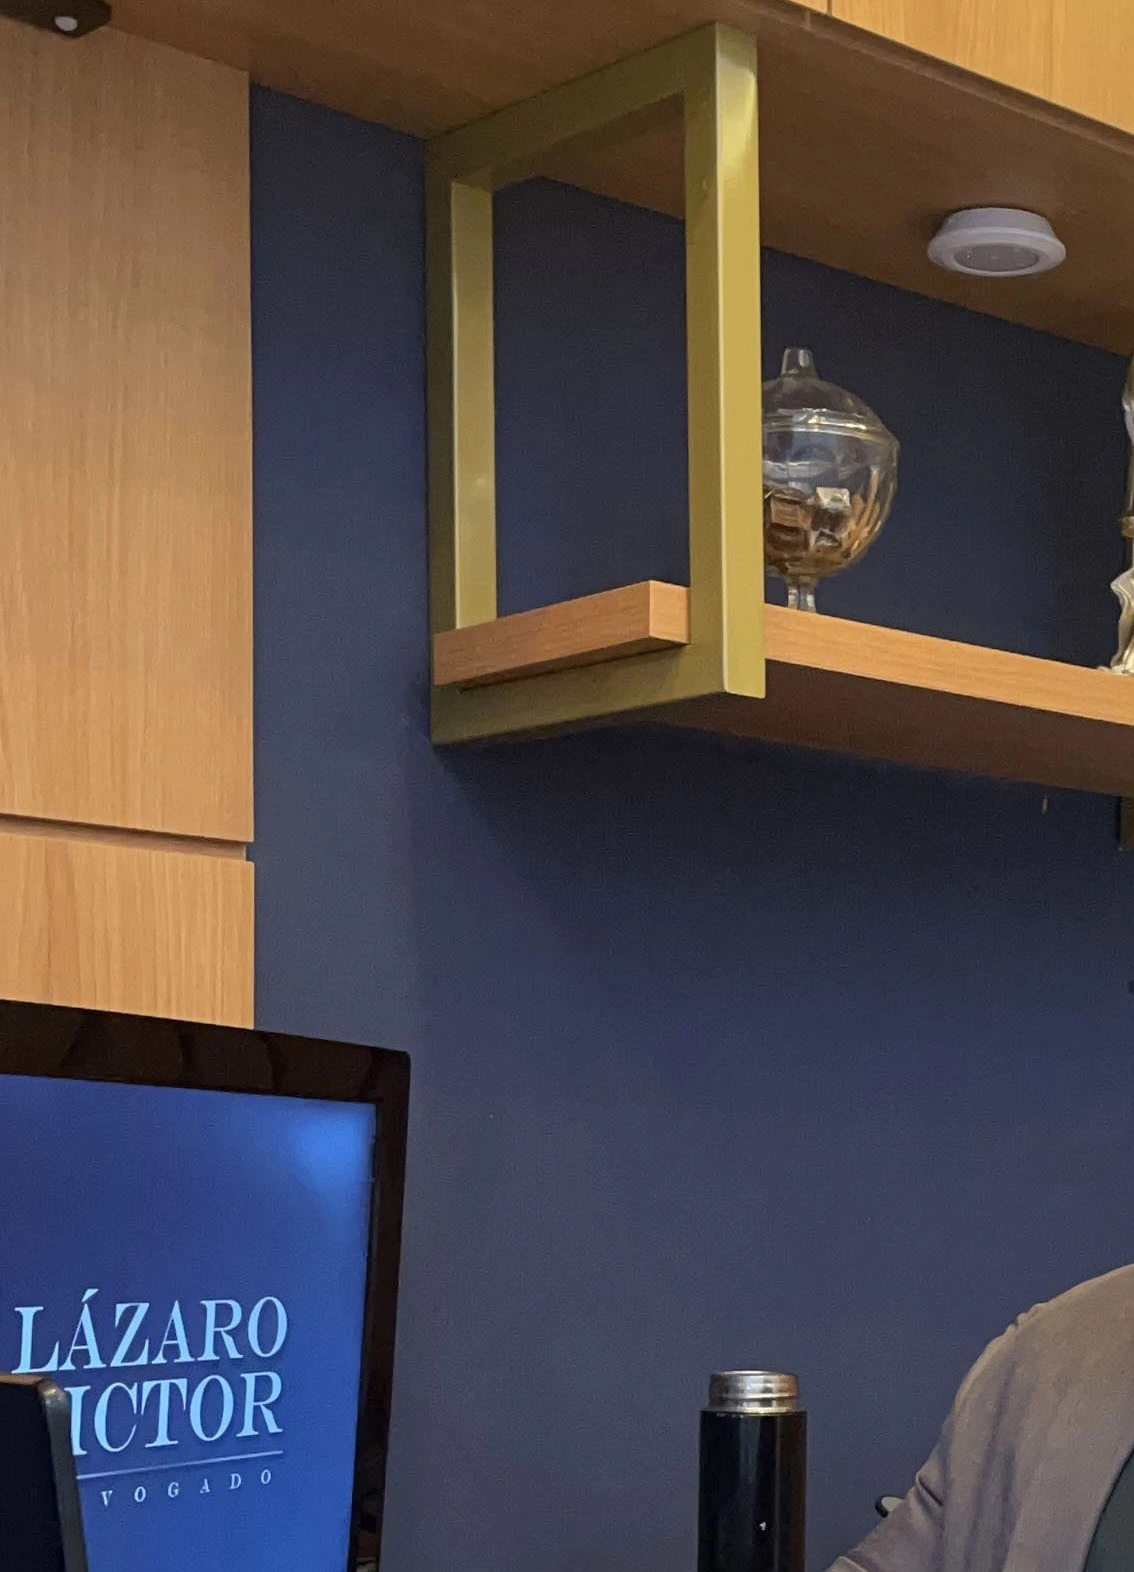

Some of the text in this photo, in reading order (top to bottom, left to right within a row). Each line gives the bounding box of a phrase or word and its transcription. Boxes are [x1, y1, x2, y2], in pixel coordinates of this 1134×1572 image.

[12, 1288, 289, 1375] LÁZARO
[64, 1370, 284, 1456] ICTOR
[100, 1468, 273, 1507] VOGADO
